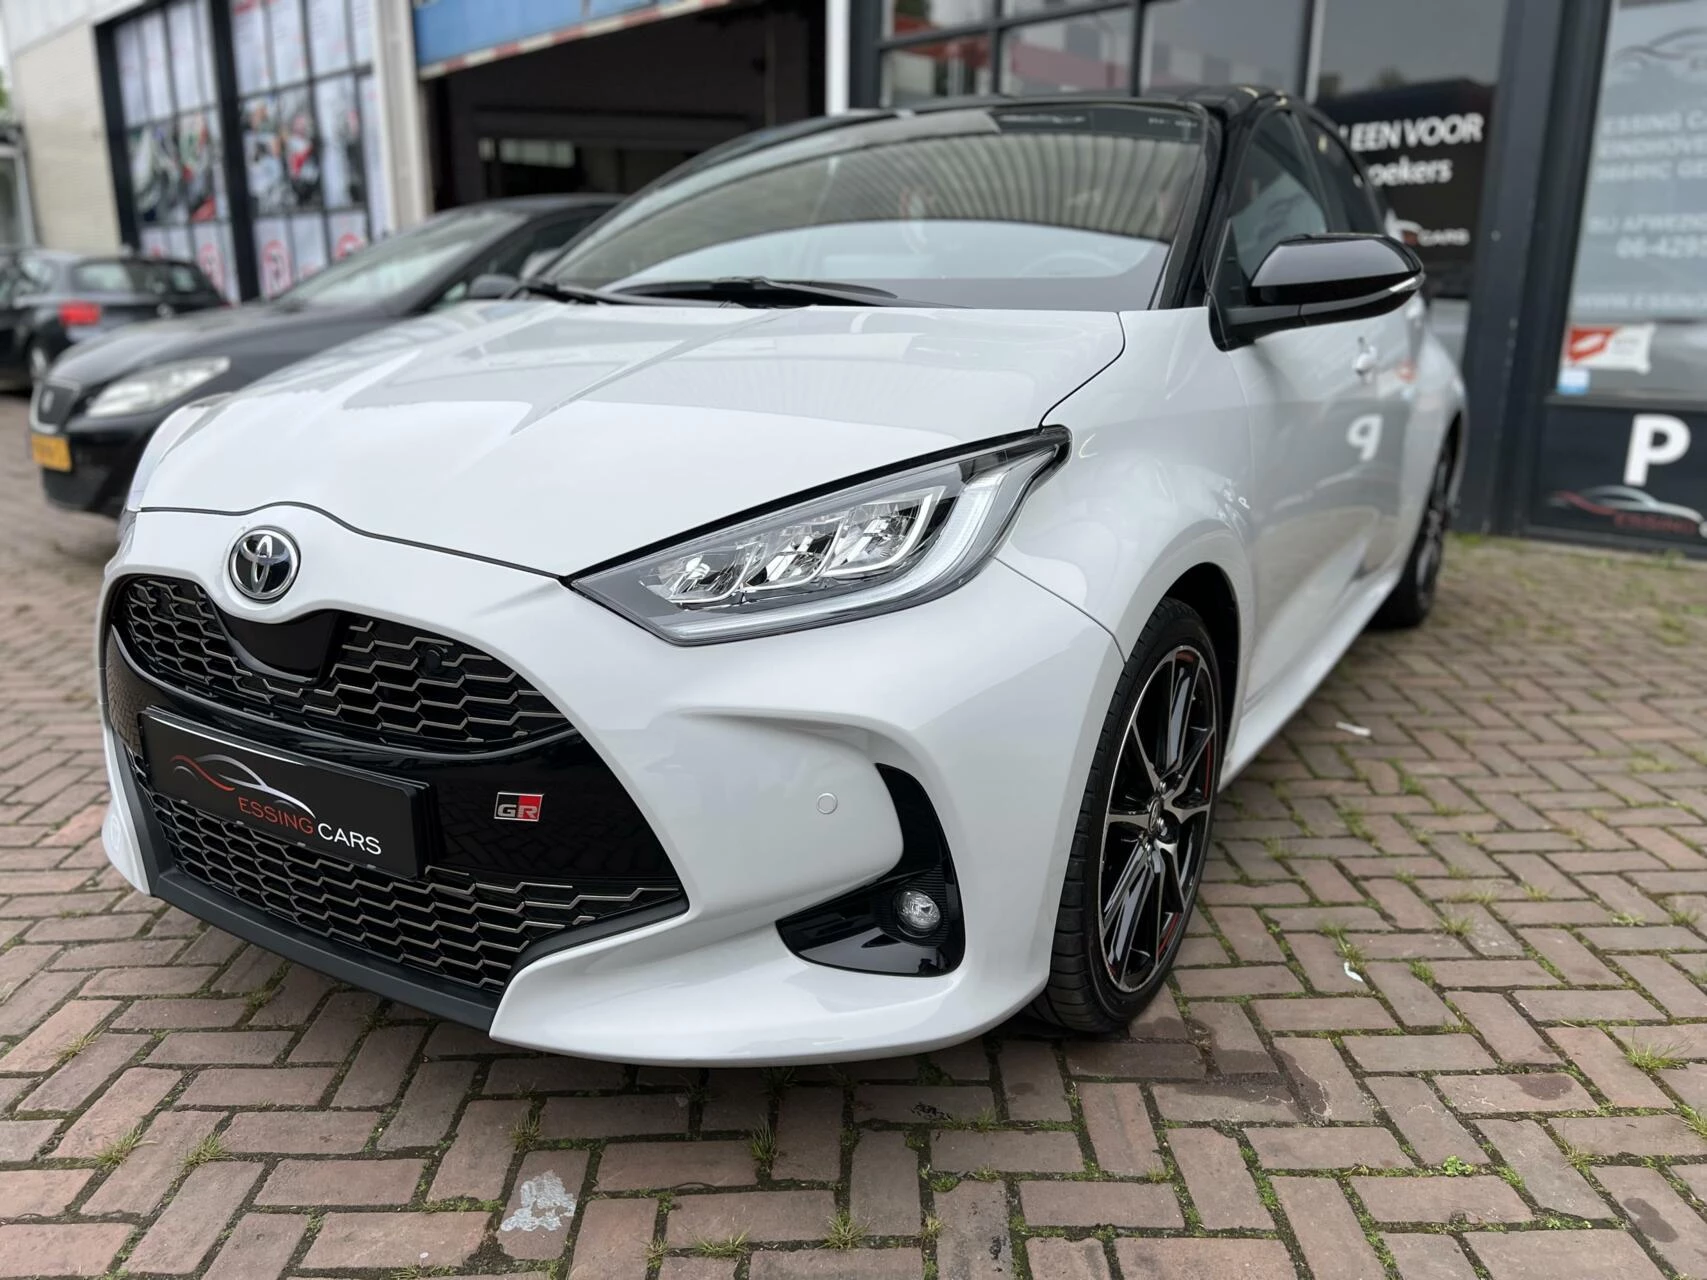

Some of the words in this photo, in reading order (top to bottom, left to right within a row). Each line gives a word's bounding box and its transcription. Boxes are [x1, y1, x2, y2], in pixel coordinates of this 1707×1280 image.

[1403, 113, 1484, 148] VOOR
[1623, 413, 1691, 487] P
[238, 796, 314, 834] ESSING
[317, 822, 382, 856] CARS
[497, 803, 538, 819] GR
